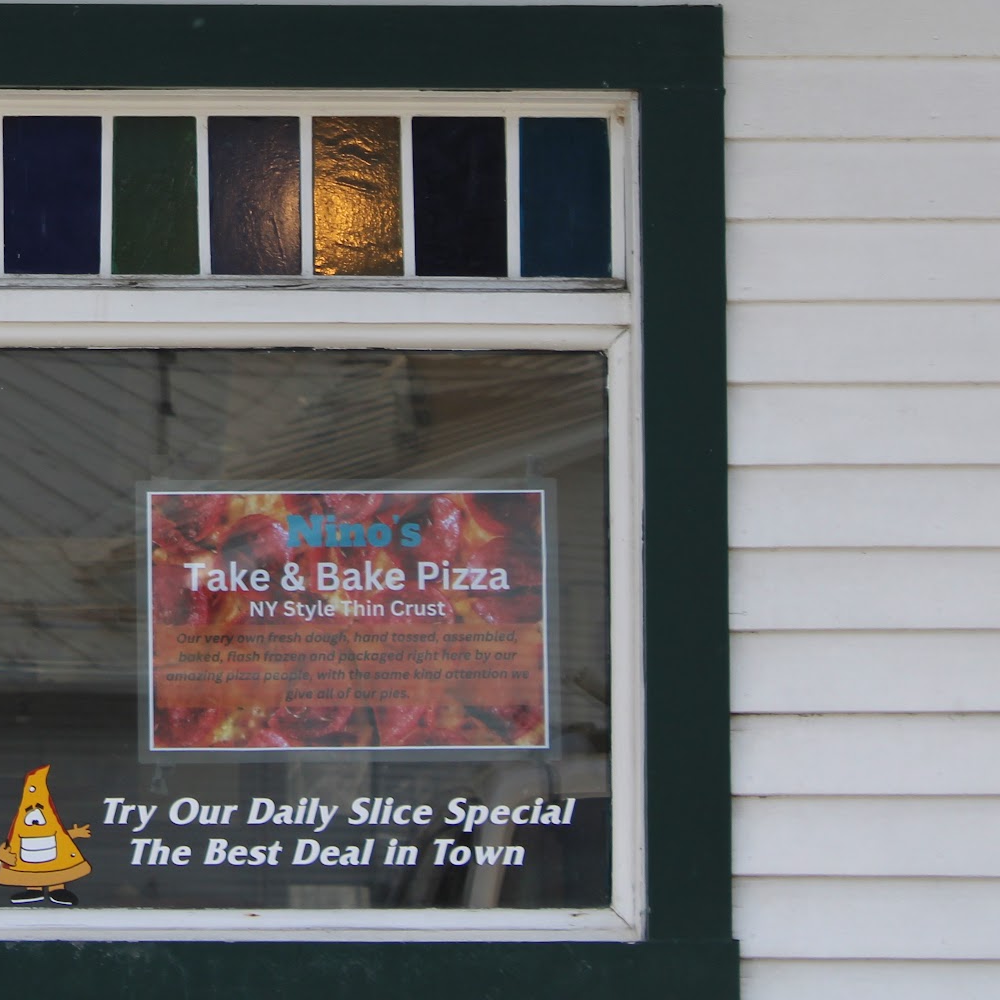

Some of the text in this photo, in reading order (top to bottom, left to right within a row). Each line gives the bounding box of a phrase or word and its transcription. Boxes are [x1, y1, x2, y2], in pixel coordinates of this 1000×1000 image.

[286, 514, 421, 547] Nino's
[183, 560, 510, 592] Take & Bake Pizza
[250, 600, 446, 621] NY Style Thin Crust
[102, 797, 575, 833] Try Our Daily Slice Special
[130, 838, 526, 867] The Best Deal in Town
